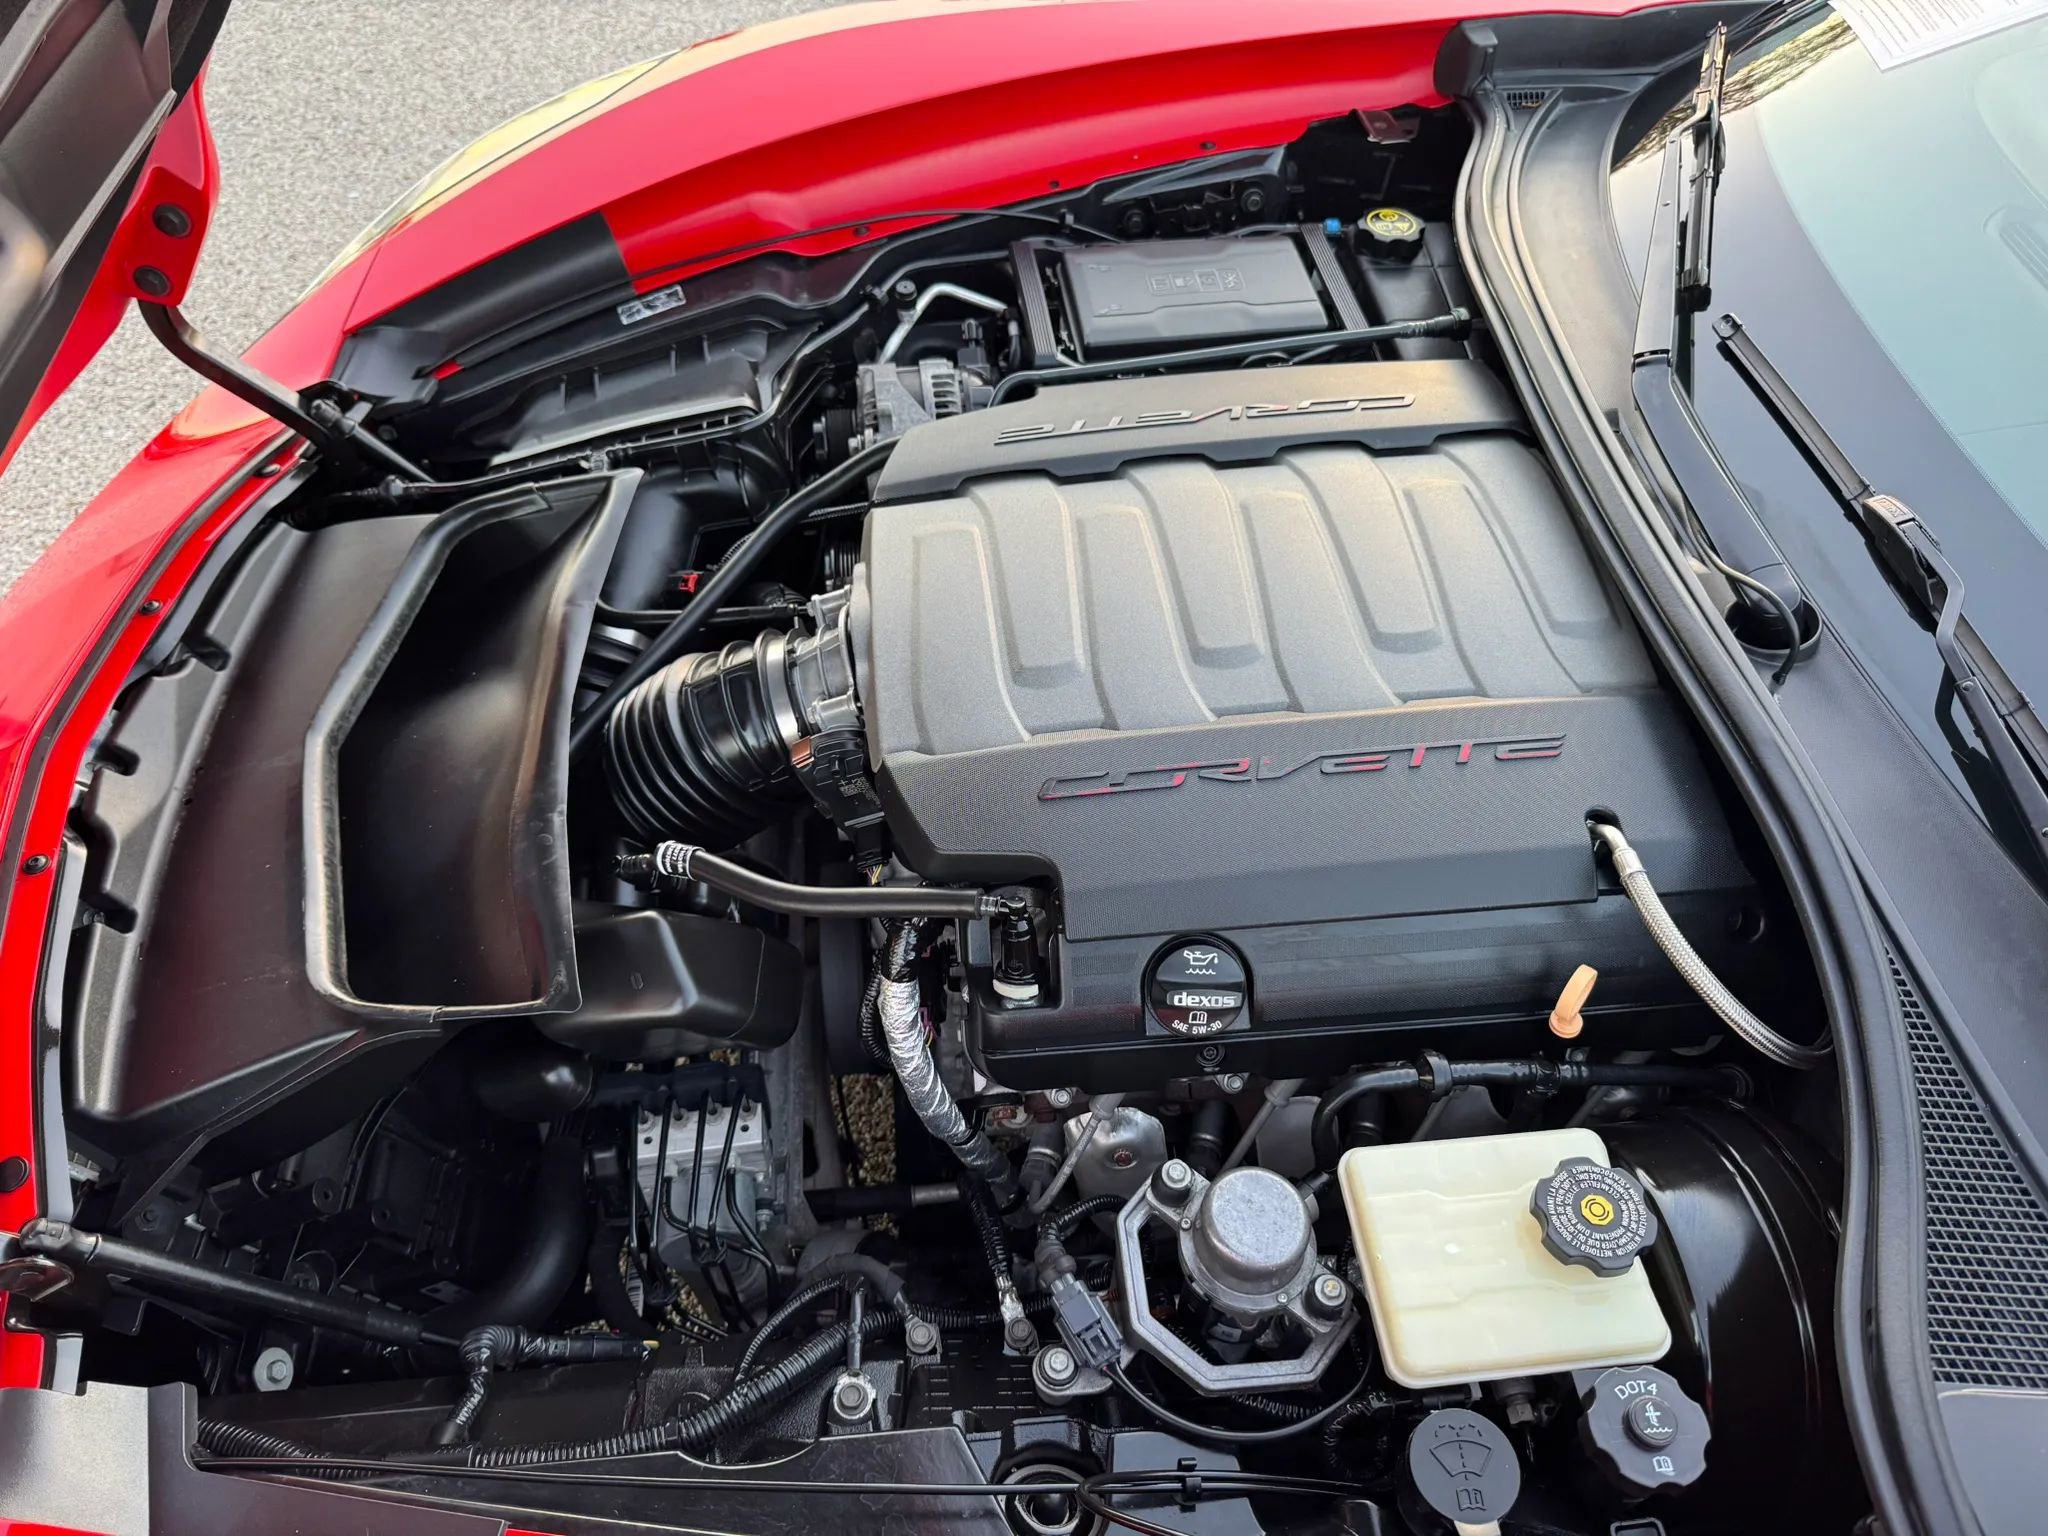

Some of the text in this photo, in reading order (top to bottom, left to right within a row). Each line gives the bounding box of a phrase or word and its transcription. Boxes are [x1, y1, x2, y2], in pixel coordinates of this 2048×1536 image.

[994, 393, 1416, 445] CORVETTE
[1038, 733, 1567, 800] CORVETTE
[1174, 992, 1237, 1007] dexos
[1172, 1019, 1222, 1034] SAE 5W-30
[1548, 1187, 1556, 1196] LA
[1578, 1180, 1600, 1189] FILLER
[1600, 1182, 1621, 1199] CLEAN
[1555, 1187, 1566, 1204] FREIN
[1547, 1196, 1556, 1214] AVANT
[1556, 1205, 1564, 1213] DE
[1626, 1199, 1637, 1221] BEFORE
[1564, 1205, 1578, 1224] BIDON
[1550, 1215, 1572, 1241] BOUCHON
[1558, 1214, 1578, 1236] LIQUIDE
[1591, 1225, 1626, 1240] PROVENANT
[1570, 1238, 1580, 1247] LE
[1575, 1232, 1586, 1242] DU
[1586, 1237, 1599, 1247] QUE
[1579, 1243, 1613, 1256] NETTOYER
[1615, 1380, 1657, 1399] DOT4
